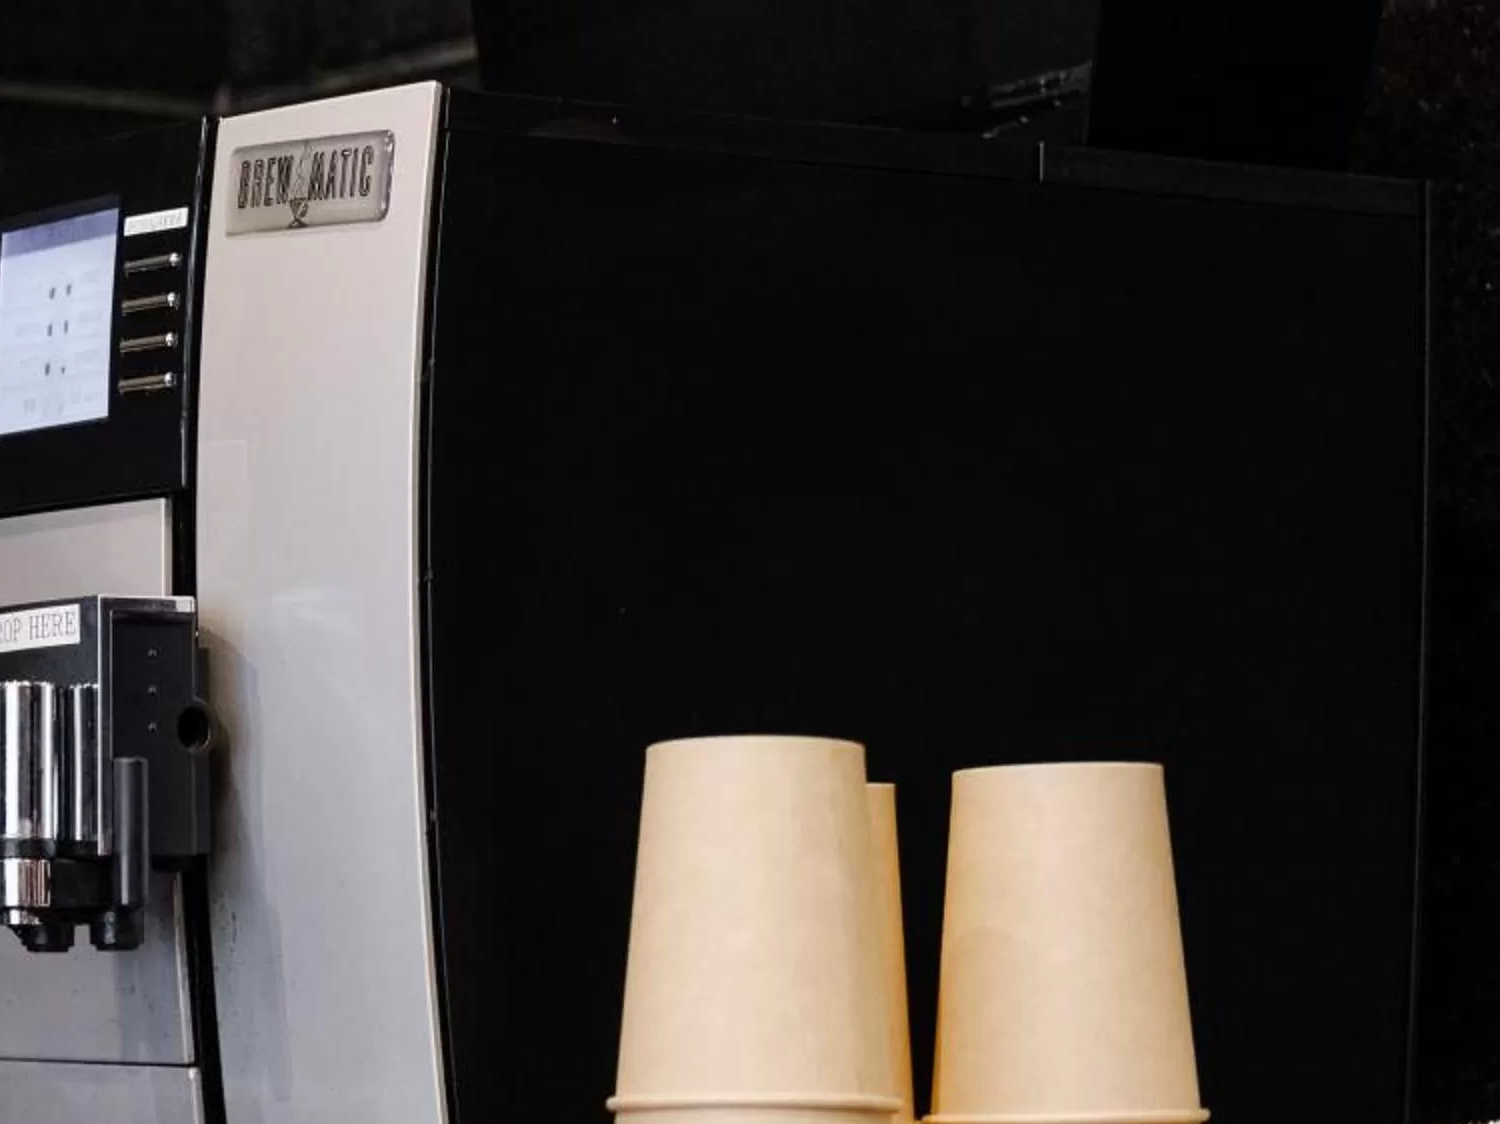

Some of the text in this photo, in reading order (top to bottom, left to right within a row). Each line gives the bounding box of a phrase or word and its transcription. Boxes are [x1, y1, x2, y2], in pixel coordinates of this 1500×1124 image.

[237, 145, 374, 210] BREW MATIC
[29, 611, 77, 641] HERE
